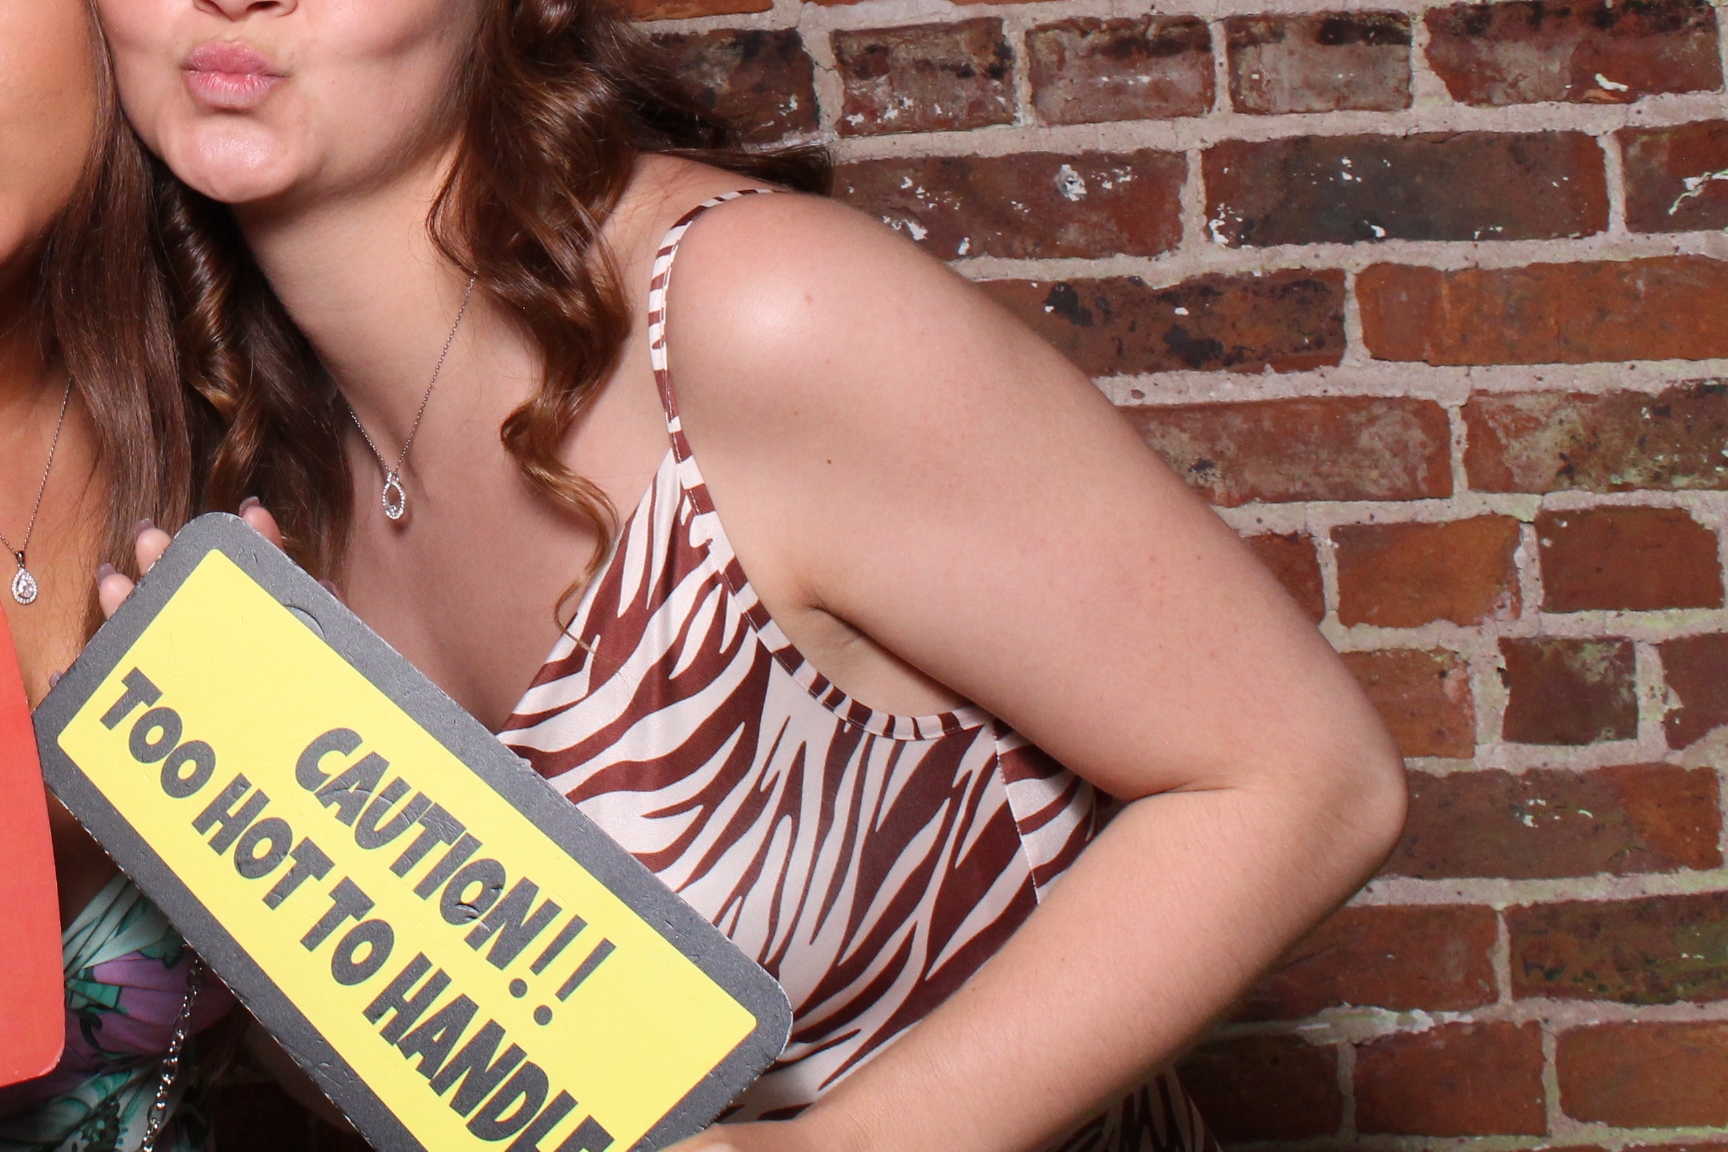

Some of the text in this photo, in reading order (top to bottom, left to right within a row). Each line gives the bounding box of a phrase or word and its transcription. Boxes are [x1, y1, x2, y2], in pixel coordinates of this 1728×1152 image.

[98, 667, 216, 799] TOO
[191, 772, 335, 910] HOT
[304, 875, 395, 986] TO
[294, 727, 617, 1026] CAUTION!!
